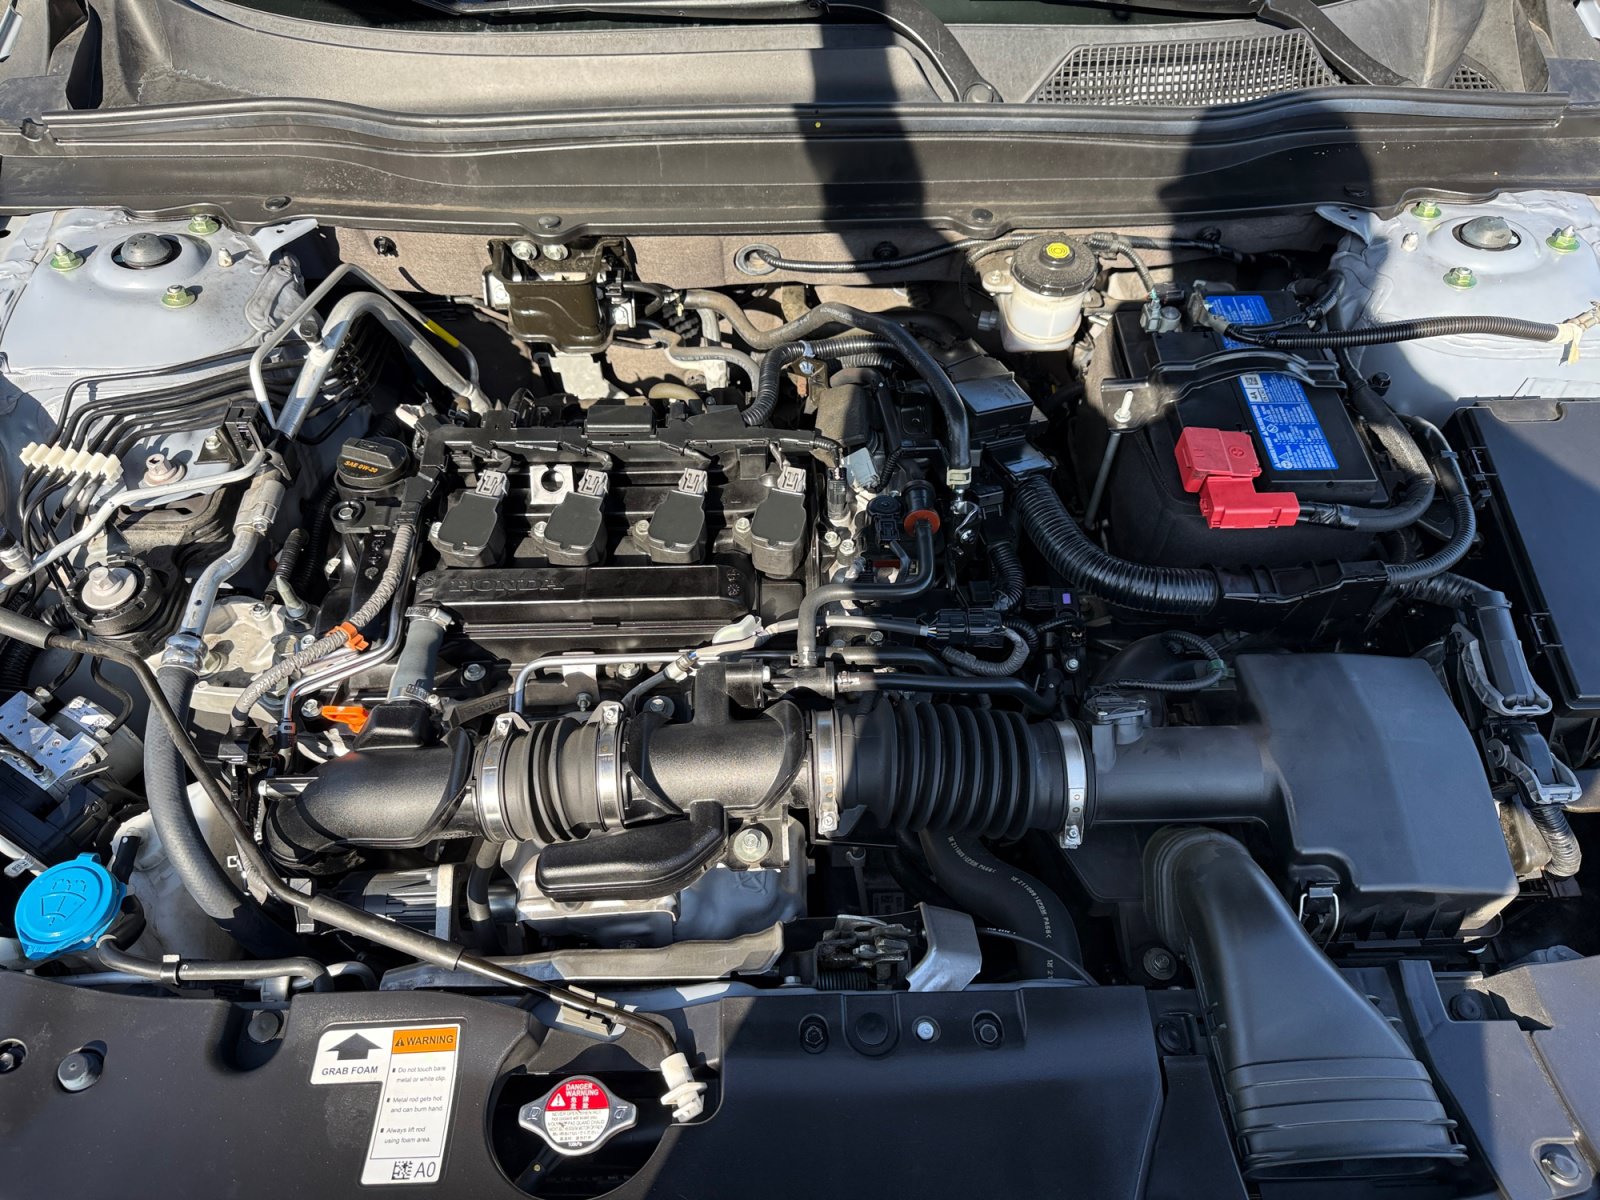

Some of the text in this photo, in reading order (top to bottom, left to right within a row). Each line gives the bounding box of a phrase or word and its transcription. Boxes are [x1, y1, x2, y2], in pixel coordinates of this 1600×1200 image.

[343, 460, 379, 473] SAE 0W-20
[450, 578, 565, 592] HONDA
[406, 1034, 454, 1046] WARNING
[321, 1065, 379, 1076] GRAB FOAM
[419, 1096, 432, 1104] gets
[384, 1137, 400, 1145] using
